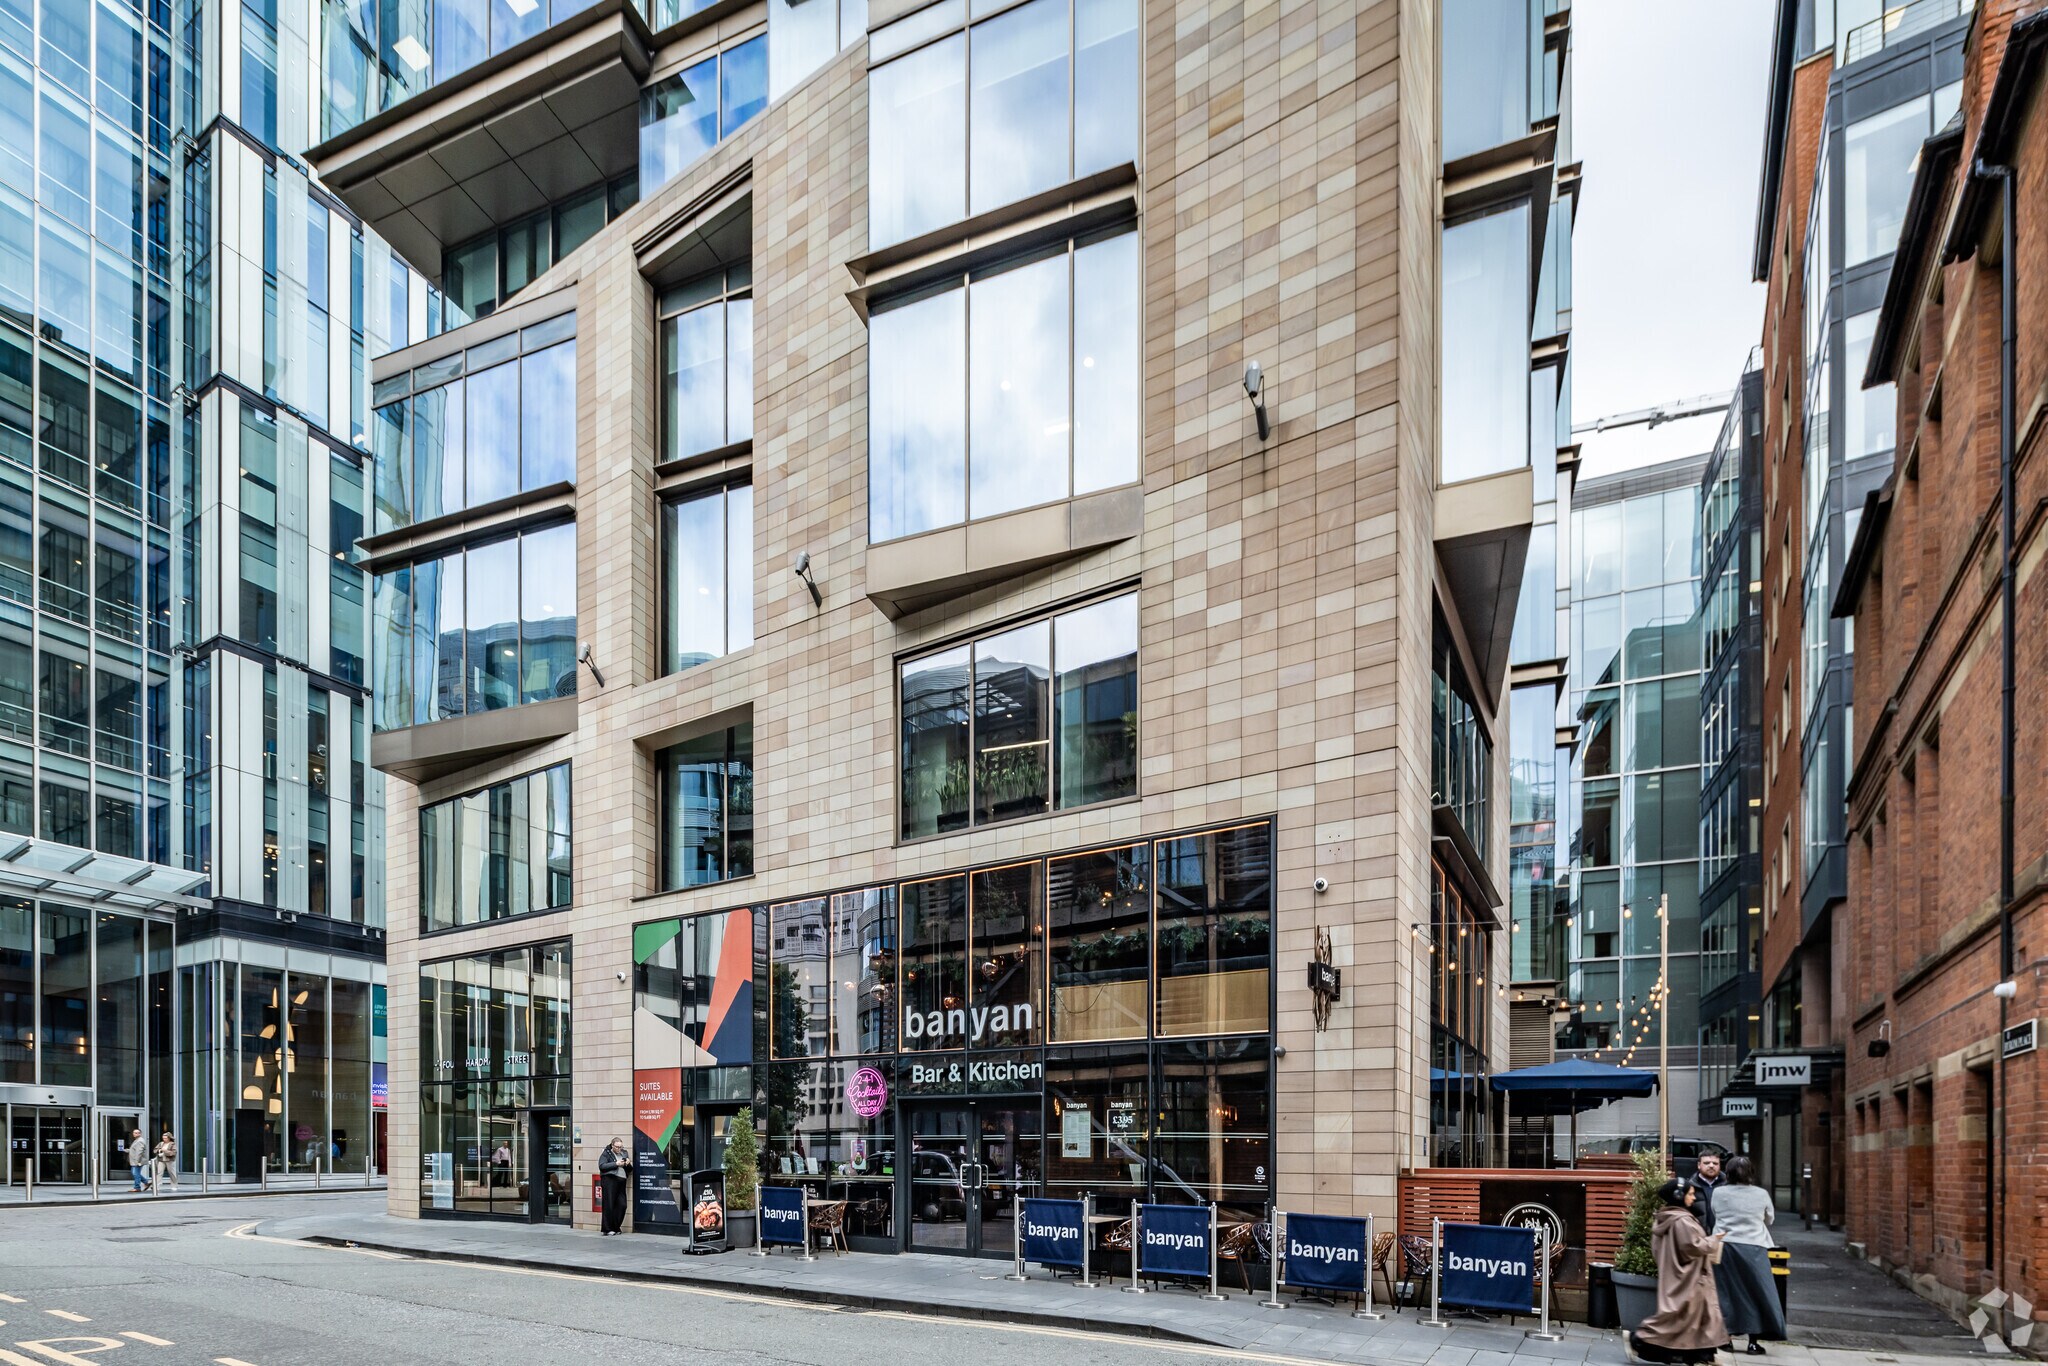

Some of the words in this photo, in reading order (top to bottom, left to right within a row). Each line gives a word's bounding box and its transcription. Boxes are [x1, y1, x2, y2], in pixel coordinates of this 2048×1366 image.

[905, 1002, 1032, 1041] banyan
[443, 1060, 454, 1069] FOU
[912, 1064, 943, 1084] Bar
[948, 1062, 962, 1083] &
[969, 1060, 1042, 1082] Kitchen
[1761, 1062, 1806, 1083] jmw
[640, 1082, 660, 1091] SUITES
[847, 1084, 885, 1099] Cocktails
[640, 1092, 673, 1101] AVAILABLE
[1111, 1101, 1133, 1109] banyan
[1726, 1101, 1754, 1114] jmw
[764, 1206, 800, 1222] banyan
[1028, 1221, 1079, 1241] banyan
[1146, 1229, 1204, 1250] banyan
[1291, 1240, 1359, 1264] banyan
[1449, 1252, 1527, 1277] banyan
